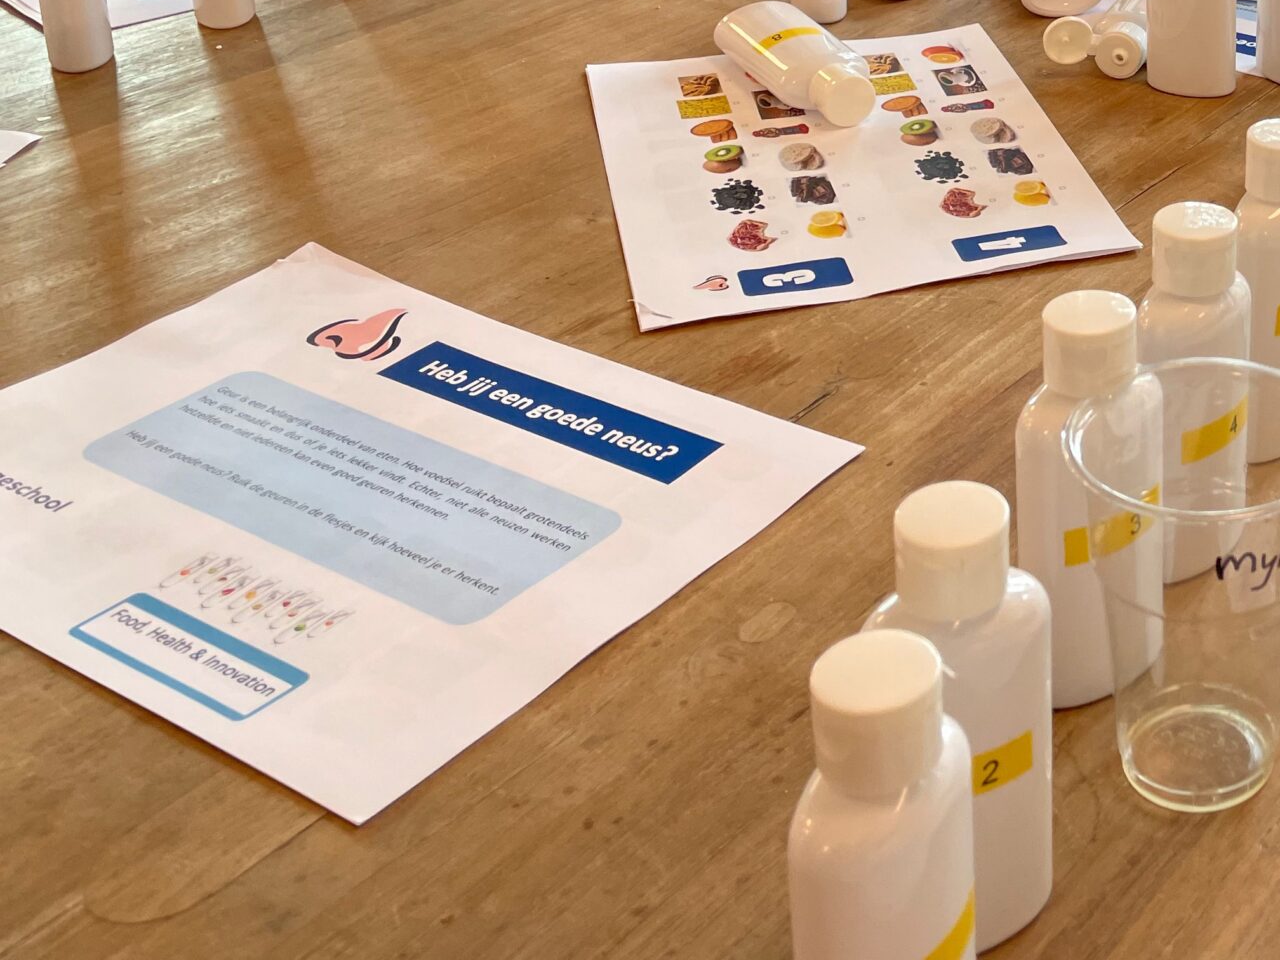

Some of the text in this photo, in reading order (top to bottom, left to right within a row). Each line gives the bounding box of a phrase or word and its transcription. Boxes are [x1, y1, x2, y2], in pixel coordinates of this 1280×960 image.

[978, 236, 1027, 251] 4
[762, 269, 816, 287] 3
[419, 360, 679, 462] Heb jij een goede neus?
[1230, 415, 1238, 433] 4
[0, 472, 74, 512] eschool
[486, 495, 527, 514] bepaalt
[490, 516, 529, 534] neuzen
[531, 532, 571, 551] werken
[1130, 514, 1140, 534] 3
[110, 608, 276, 697] Food, Health & Innovation
[982, 758, 999, 787] 2
